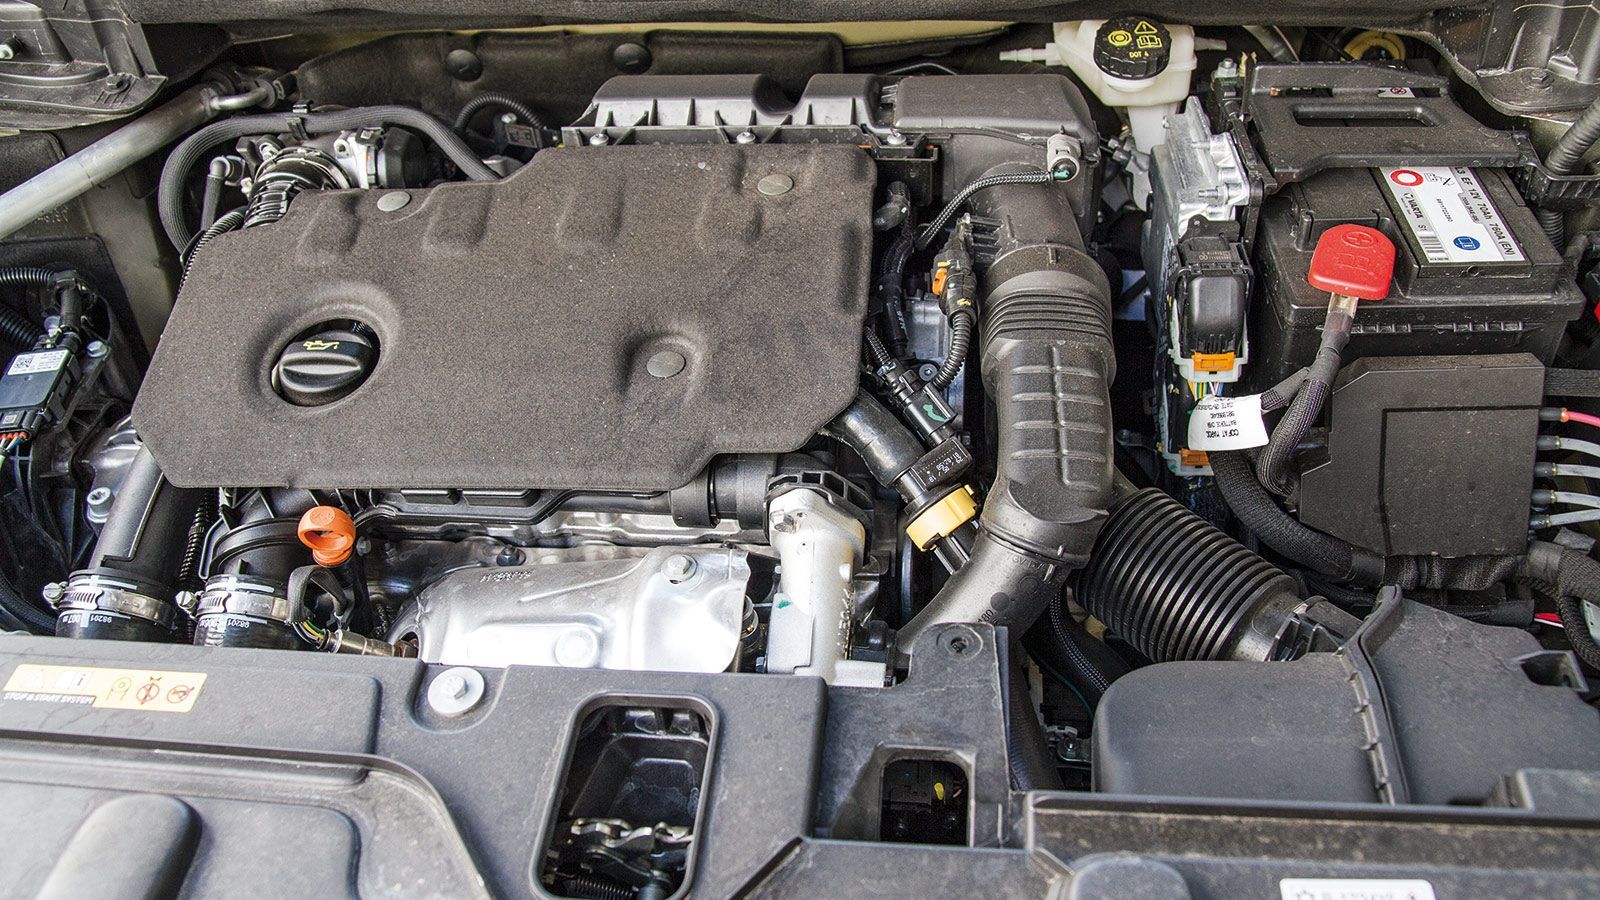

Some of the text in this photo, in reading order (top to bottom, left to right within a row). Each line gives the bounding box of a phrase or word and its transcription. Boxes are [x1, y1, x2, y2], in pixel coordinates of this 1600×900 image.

[1408, 199, 1423, 219] VARTA
[1469, 188, 1482, 200] 12V
[1477, 203, 1493, 220] 70Ah
[1489, 223, 1506, 240] 760A
[1498, 240, 1515, 256] (EN)
[90, 616, 112, 624] 98201
[4, 692, 26, 700] STOP
[34, 694, 60, 702] START
[60, 695, 93, 704] SYSTEM
